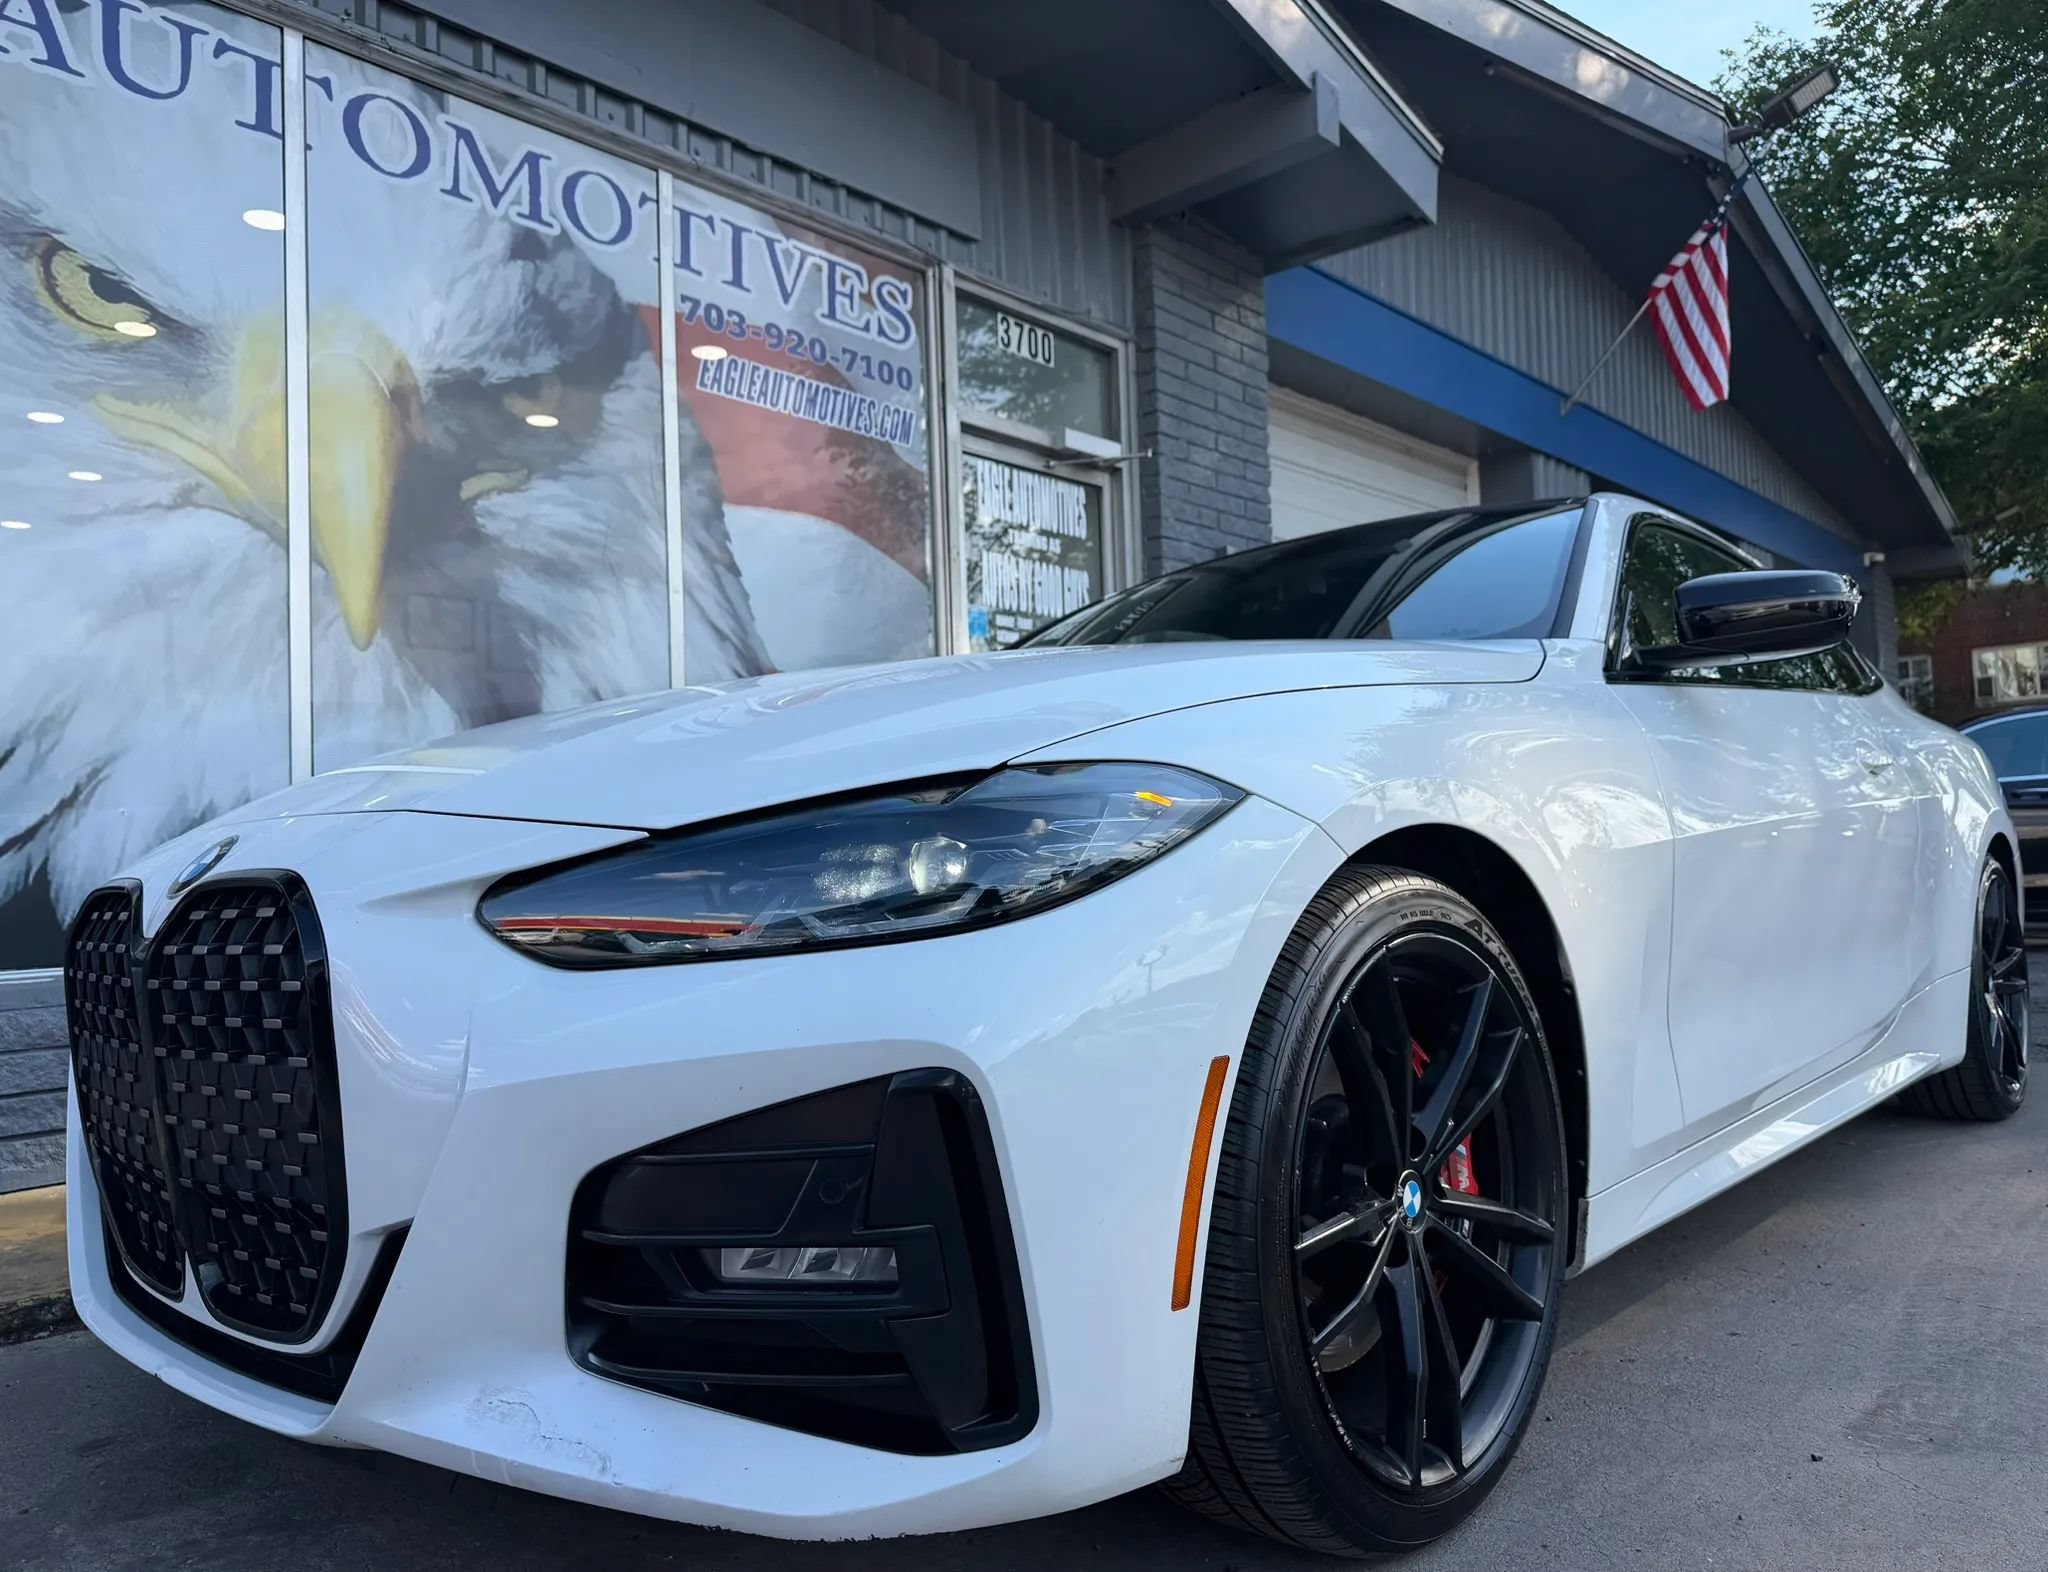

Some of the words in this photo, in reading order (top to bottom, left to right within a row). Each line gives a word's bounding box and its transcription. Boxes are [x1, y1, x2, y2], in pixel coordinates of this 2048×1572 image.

[0, 0, 912, 344] AUTOMOTIVES
[680, 294, 913, 392] 703-920-7100
[1000, 316, 1052, 365] 3700
[698, 358, 914, 446] EAGLEAUTOMOTIVES.COM
